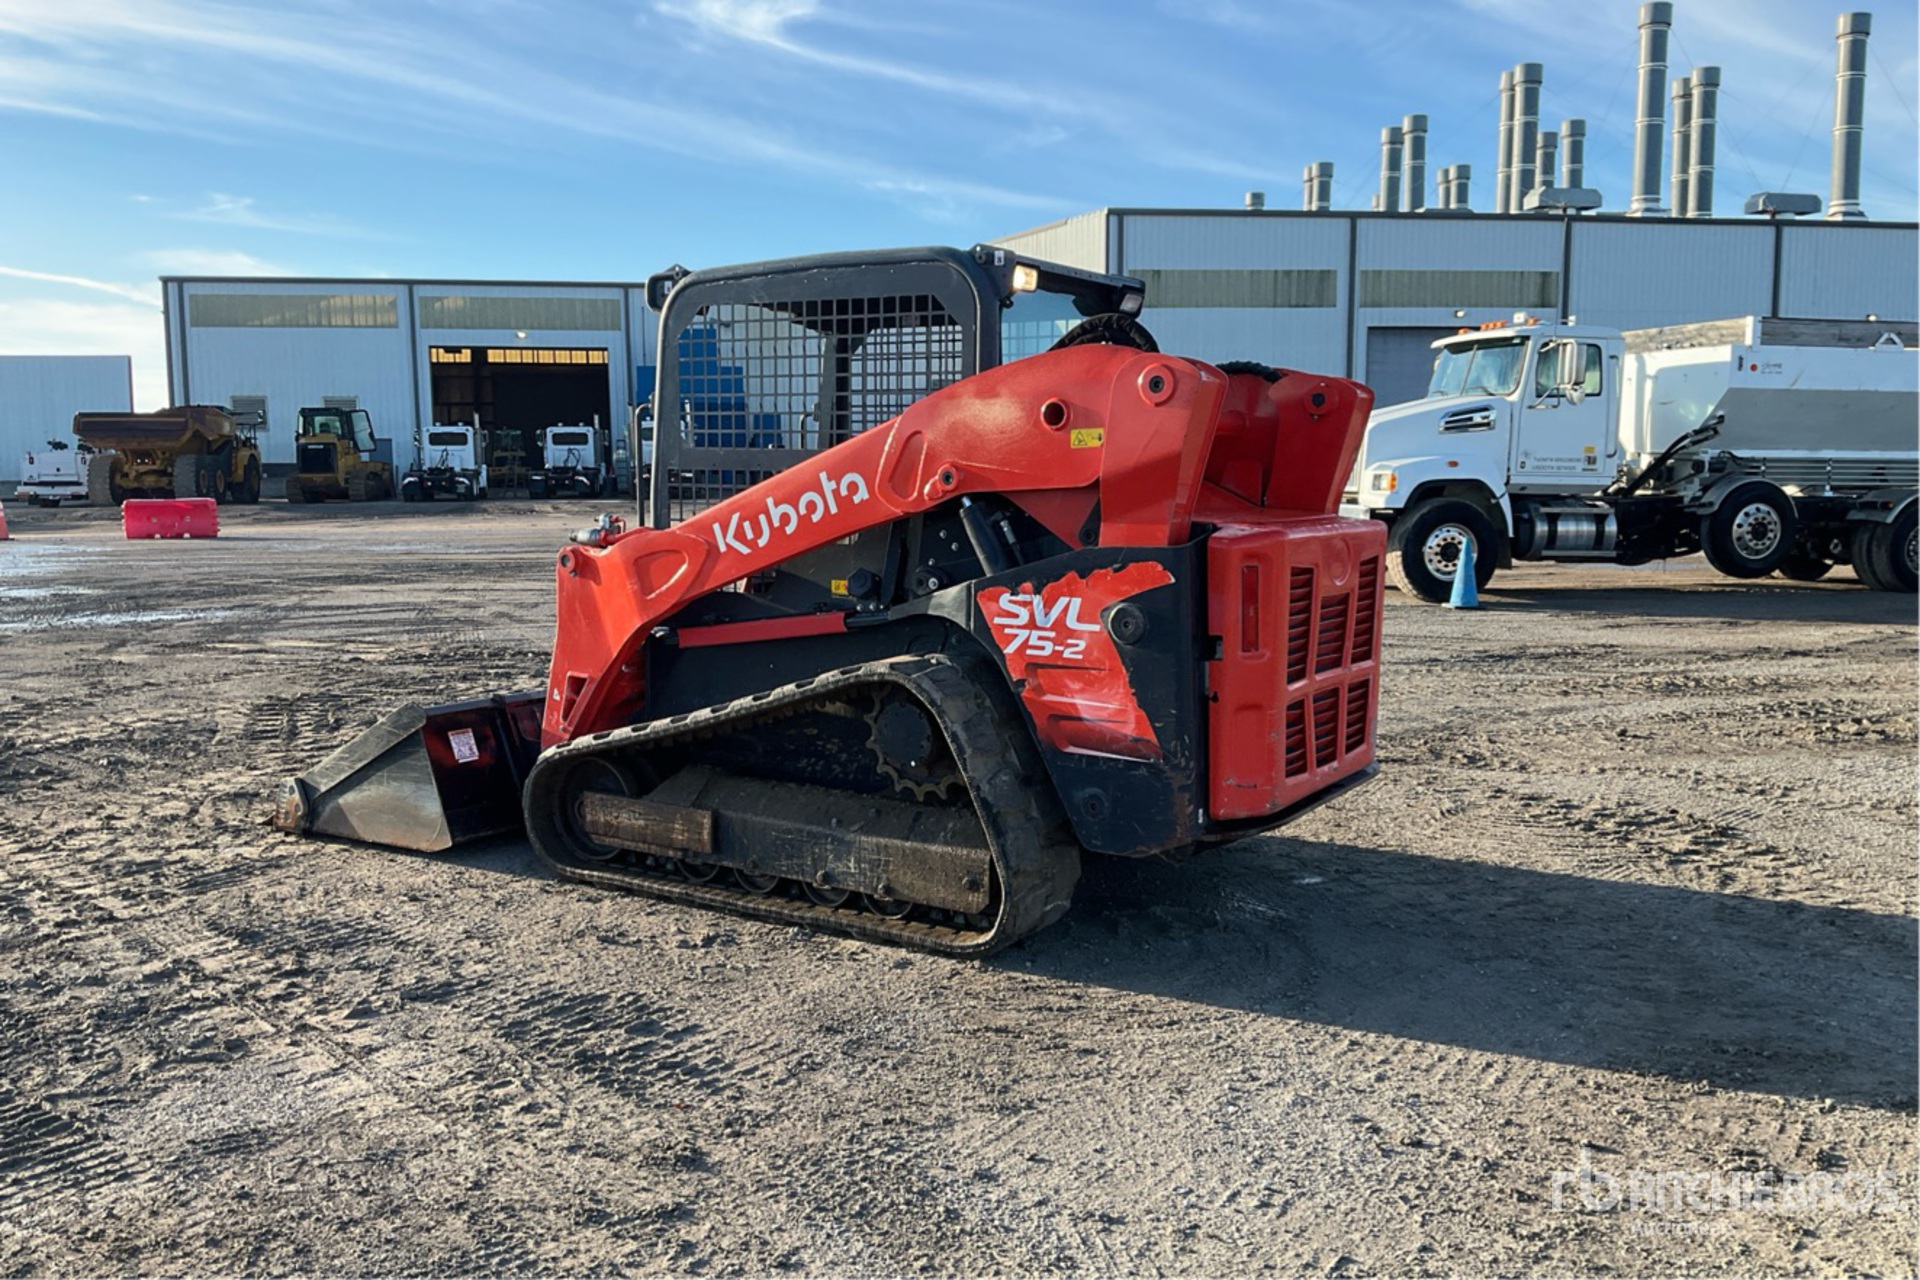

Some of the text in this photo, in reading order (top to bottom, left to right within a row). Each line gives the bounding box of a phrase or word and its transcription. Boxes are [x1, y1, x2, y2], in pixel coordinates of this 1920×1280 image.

[712, 470, 870, 555] Kubota
[993, 593, 1101, 632] SVL
[1003, 628, 1087, 660] 75-2
